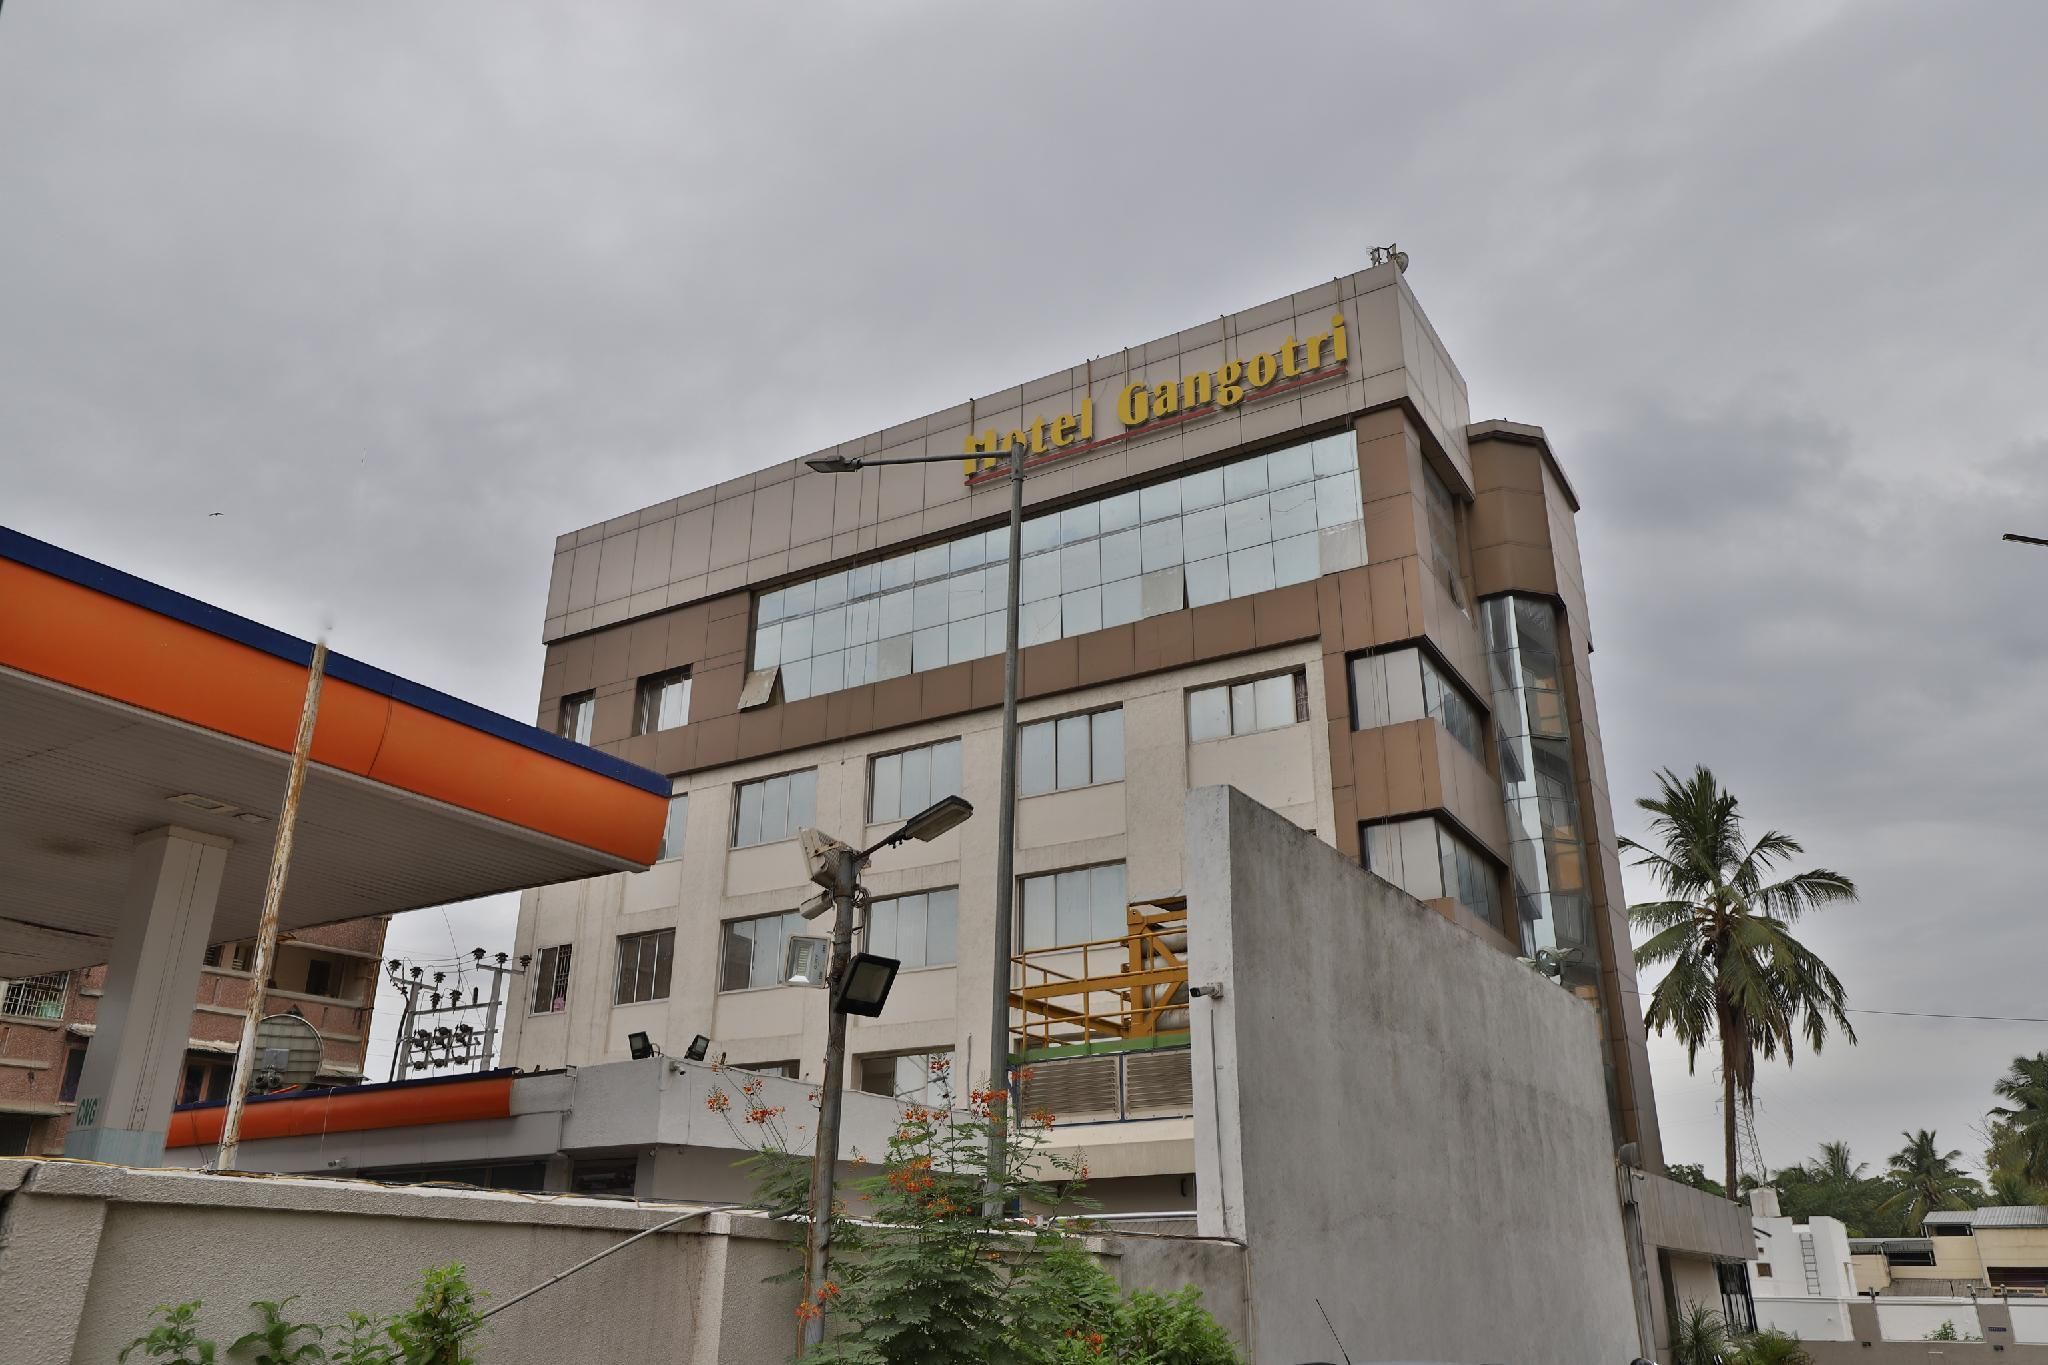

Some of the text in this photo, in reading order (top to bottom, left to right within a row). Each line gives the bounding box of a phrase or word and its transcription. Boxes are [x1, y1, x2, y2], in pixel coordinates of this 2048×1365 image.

[963, 313, 1348, 476] Hotel Gangotri
[76, 1098, 98, 1127] CNG
